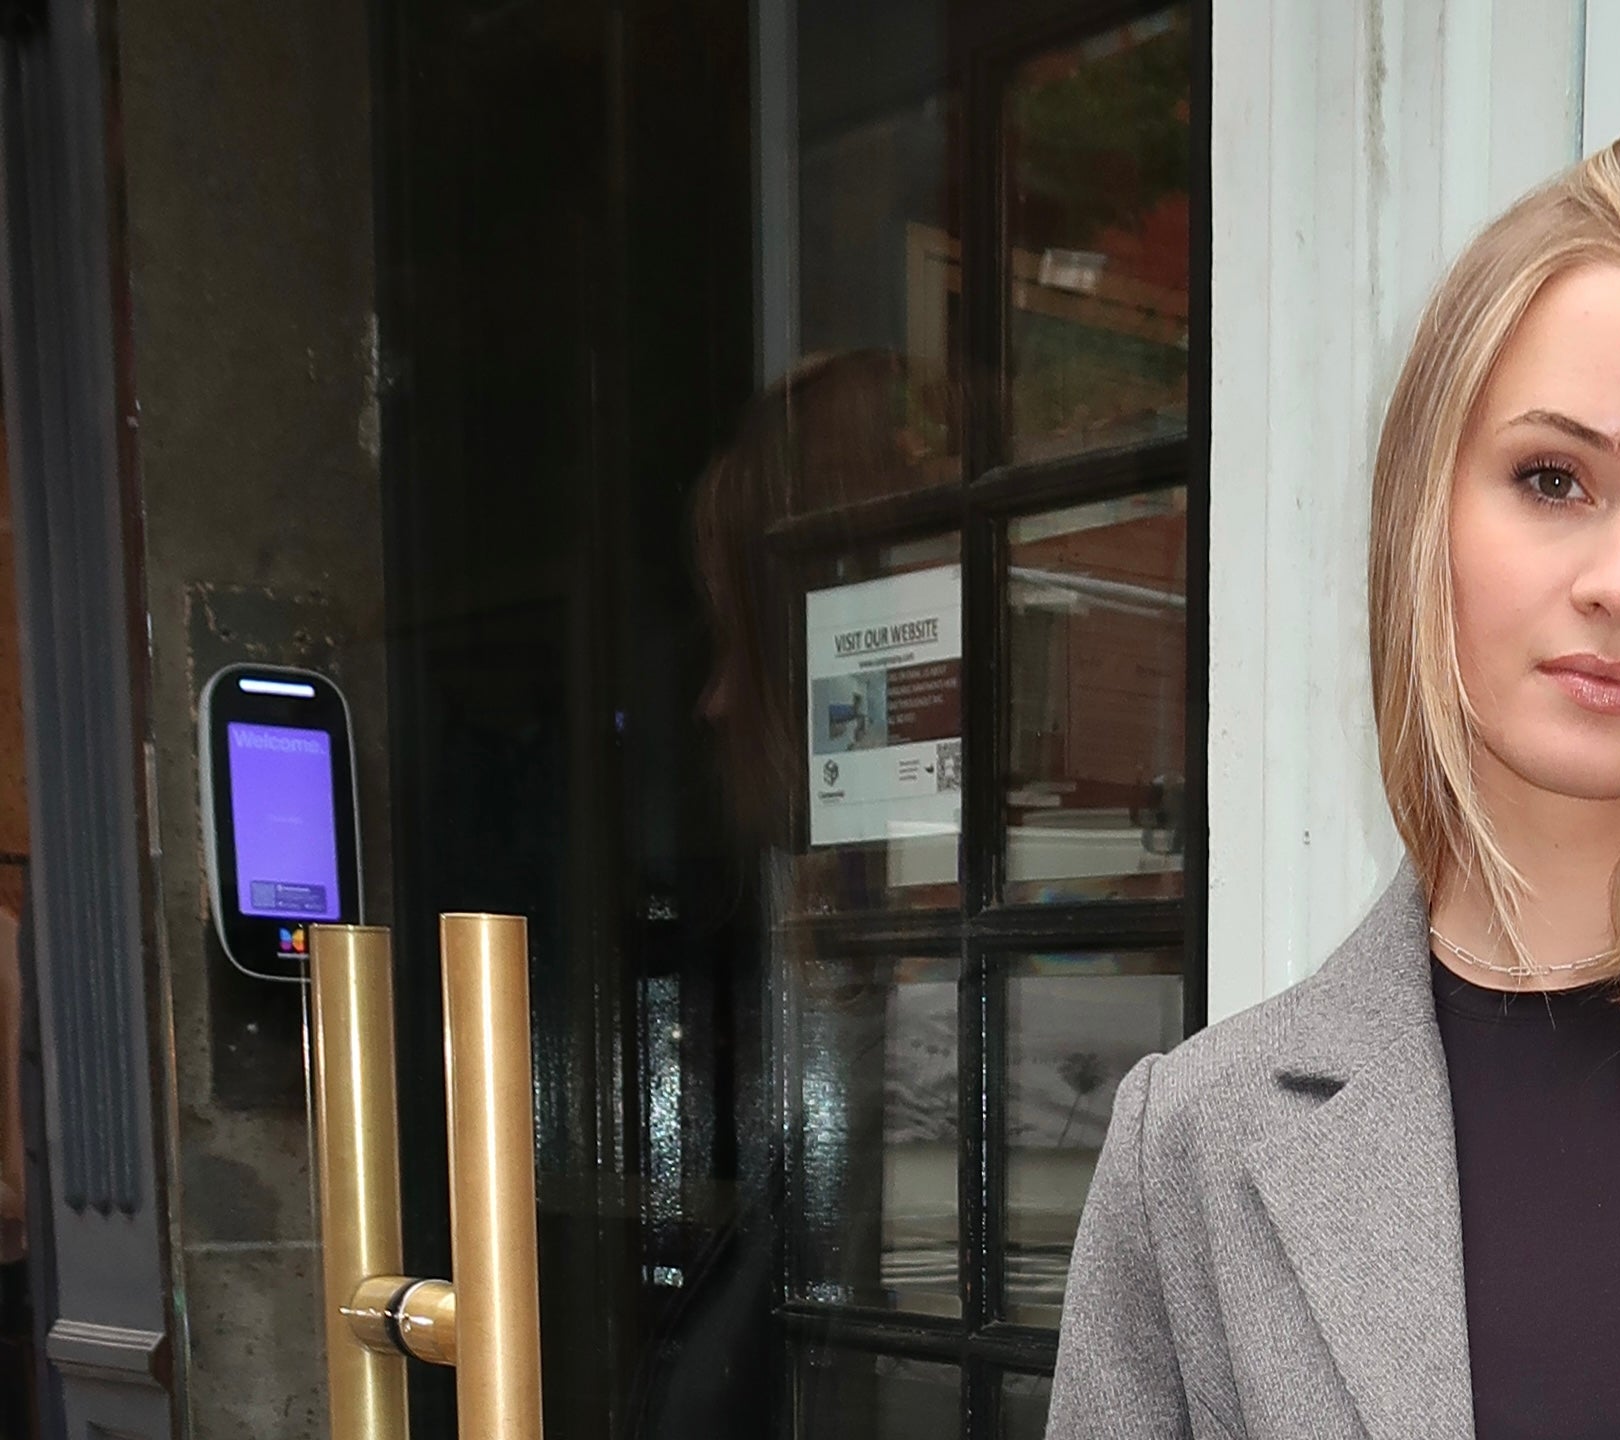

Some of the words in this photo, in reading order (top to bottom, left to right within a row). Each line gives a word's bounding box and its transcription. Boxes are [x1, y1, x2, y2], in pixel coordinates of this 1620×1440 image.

[834, 631, 862, 653] VISIT
[864, 627, 888, 649] OUR
[890, 618, 938, 643] WEBSITE
